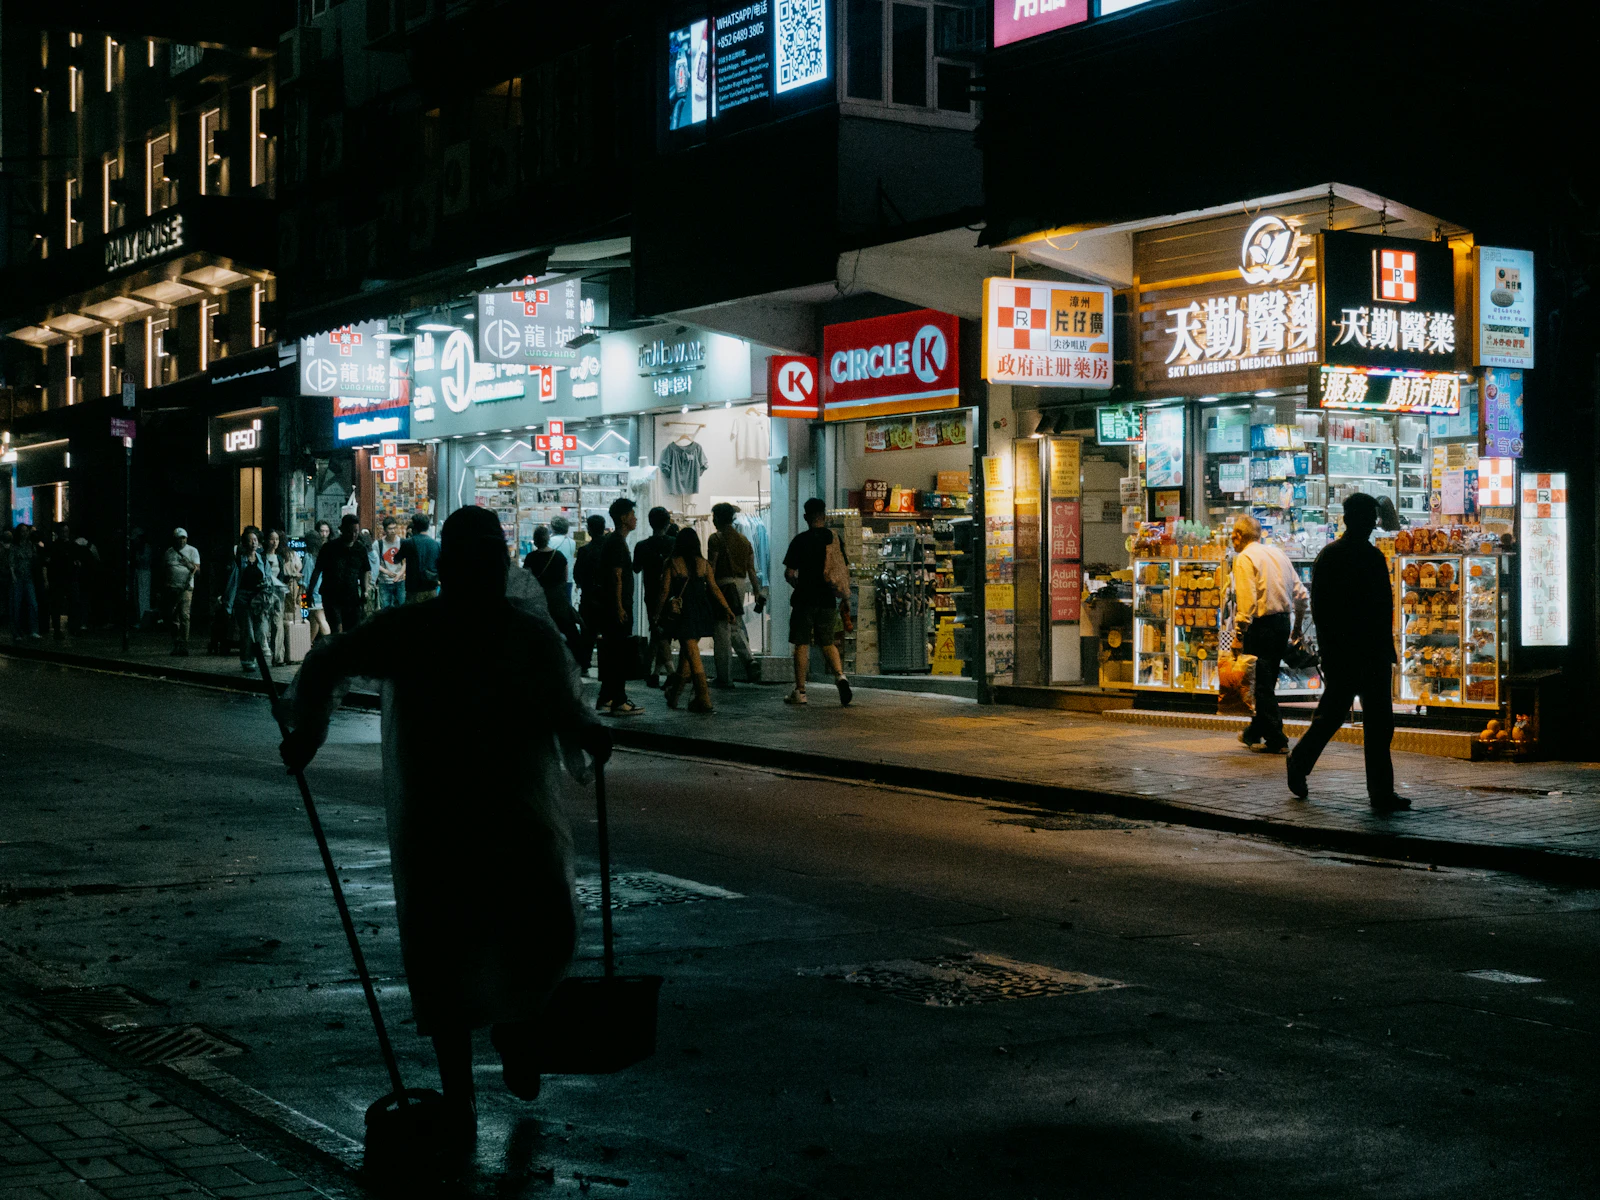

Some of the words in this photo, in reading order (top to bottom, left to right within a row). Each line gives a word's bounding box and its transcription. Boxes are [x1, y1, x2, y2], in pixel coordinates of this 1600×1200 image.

[717, 33, 733, 49] +852
[732, 27, 748, 44] 6489
[1069, 295, 1090, 309] 漳州
[1164, 282, 1317, 365] 天勤醫藥
[1340, 306, 1456, 353] 天勤醫藥
[830, 340, 909, 384] CIRCLE
[1167, 365, 1186, 379] SKY
[1187, 359, 1237, 377] DILIGENTS
[1239, 354, 1283, 371] MEDICAL
[1285, 350, 1318, 366] LIMIT
[1320, 372, 1369, 403] 服務
[1053, 524, 1078, 539] 成人
[1053, 540, 1078, 556] 用品
[1053, 569, 1077, 579] Adult
[1053, 579, 1078, 589] Store
